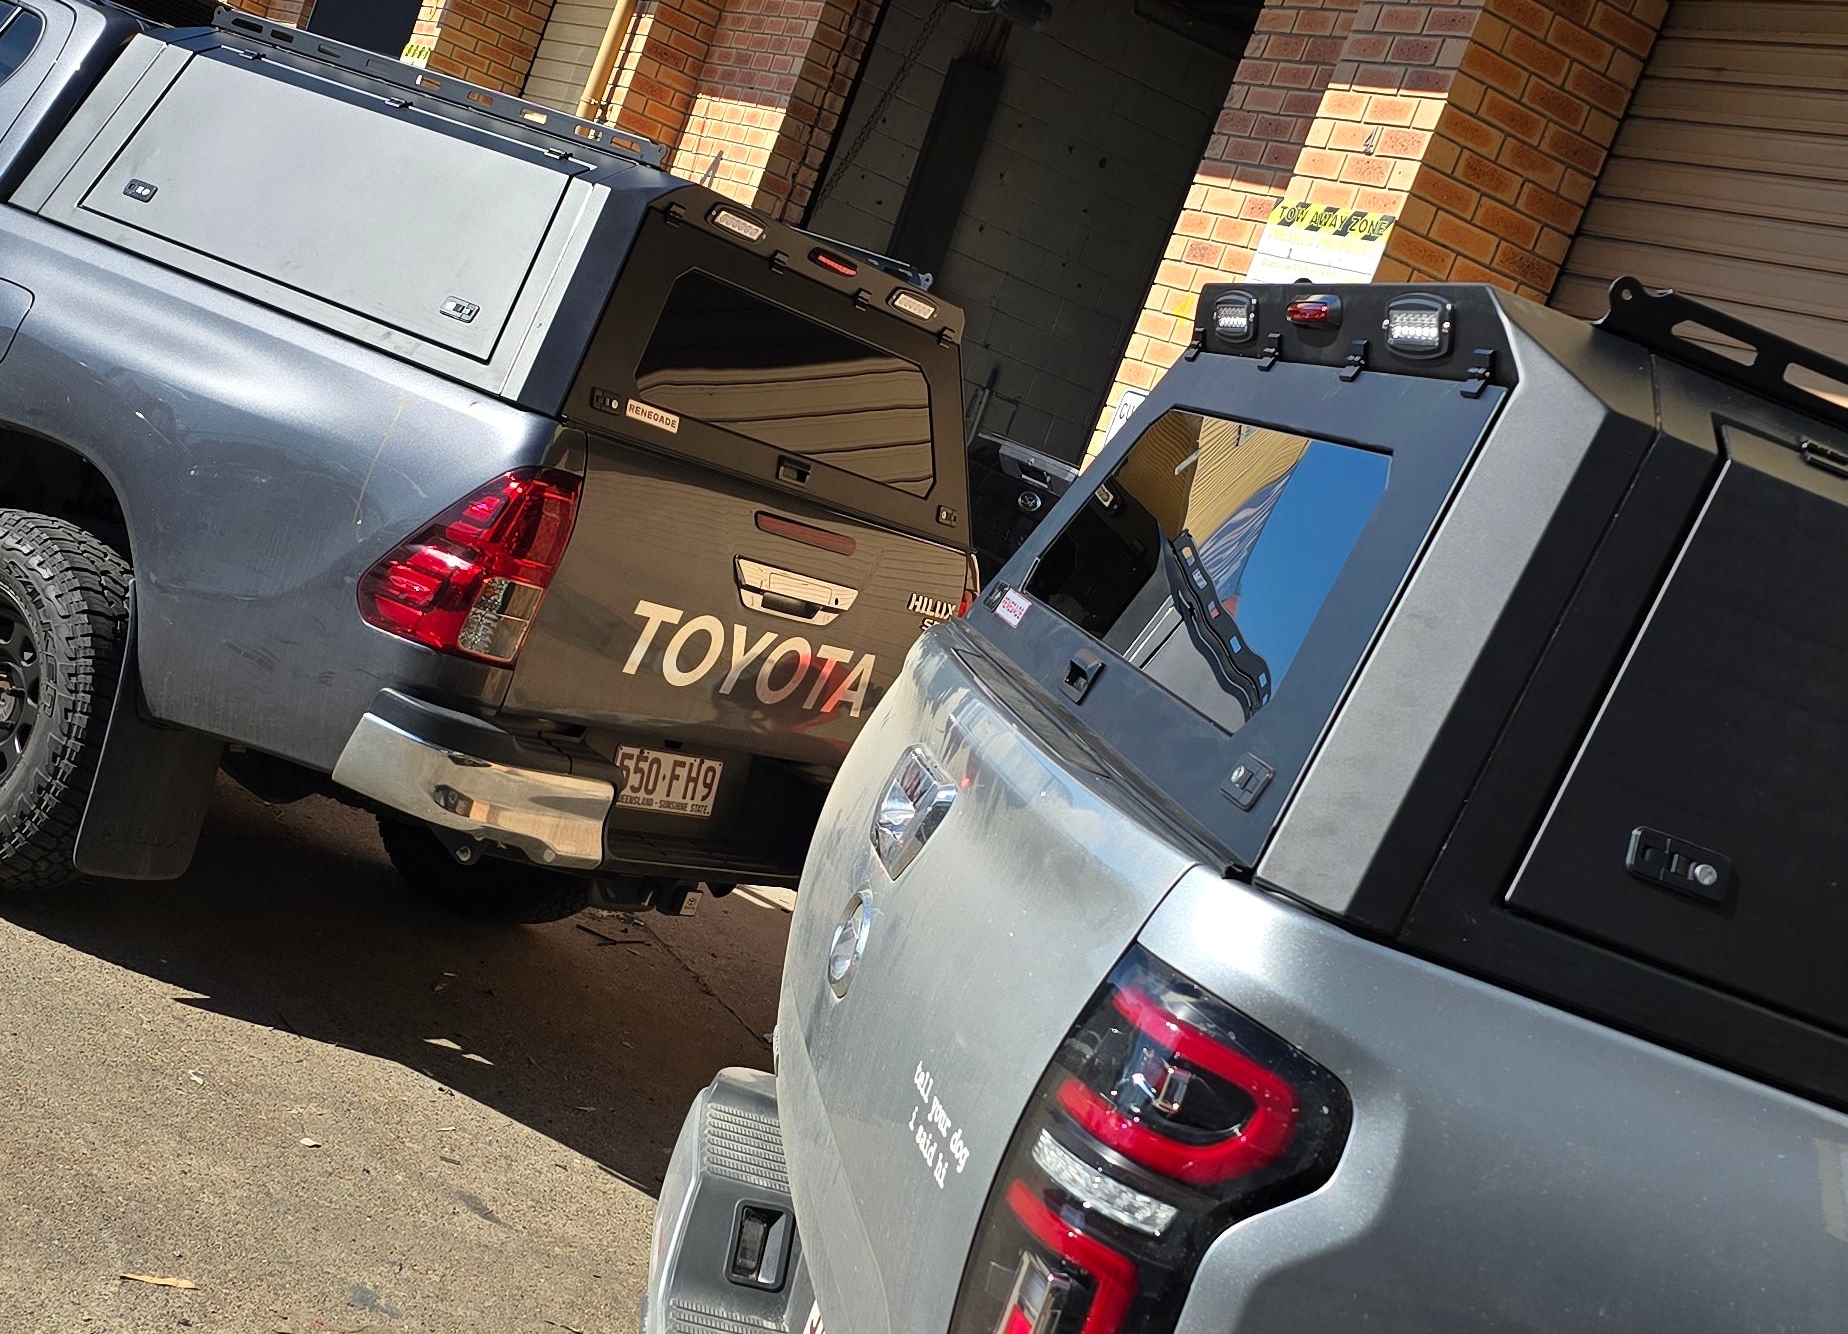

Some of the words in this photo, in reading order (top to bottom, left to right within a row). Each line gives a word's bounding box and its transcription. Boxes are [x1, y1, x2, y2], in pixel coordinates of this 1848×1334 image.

[1280, 205, 1309, 223] TOW
[1310, 211, 1348, 229] AWAY
[1348, 216, 1388, 237] ZONE
[628, 403, 678, 429] RENEGADE
[907, 593, 957, 620] HILUX
[622, 599, 876, 718] TOYOTA
[913, 1060, 934, 1104] tell
[927, 1095, 952, 1138] your
[949, 1128, 970, 1174] dog
[908, 1105, 919, 1132] i
[915, 1124, 938, 1168] said
[933, 1152, 949, 1190] hi
